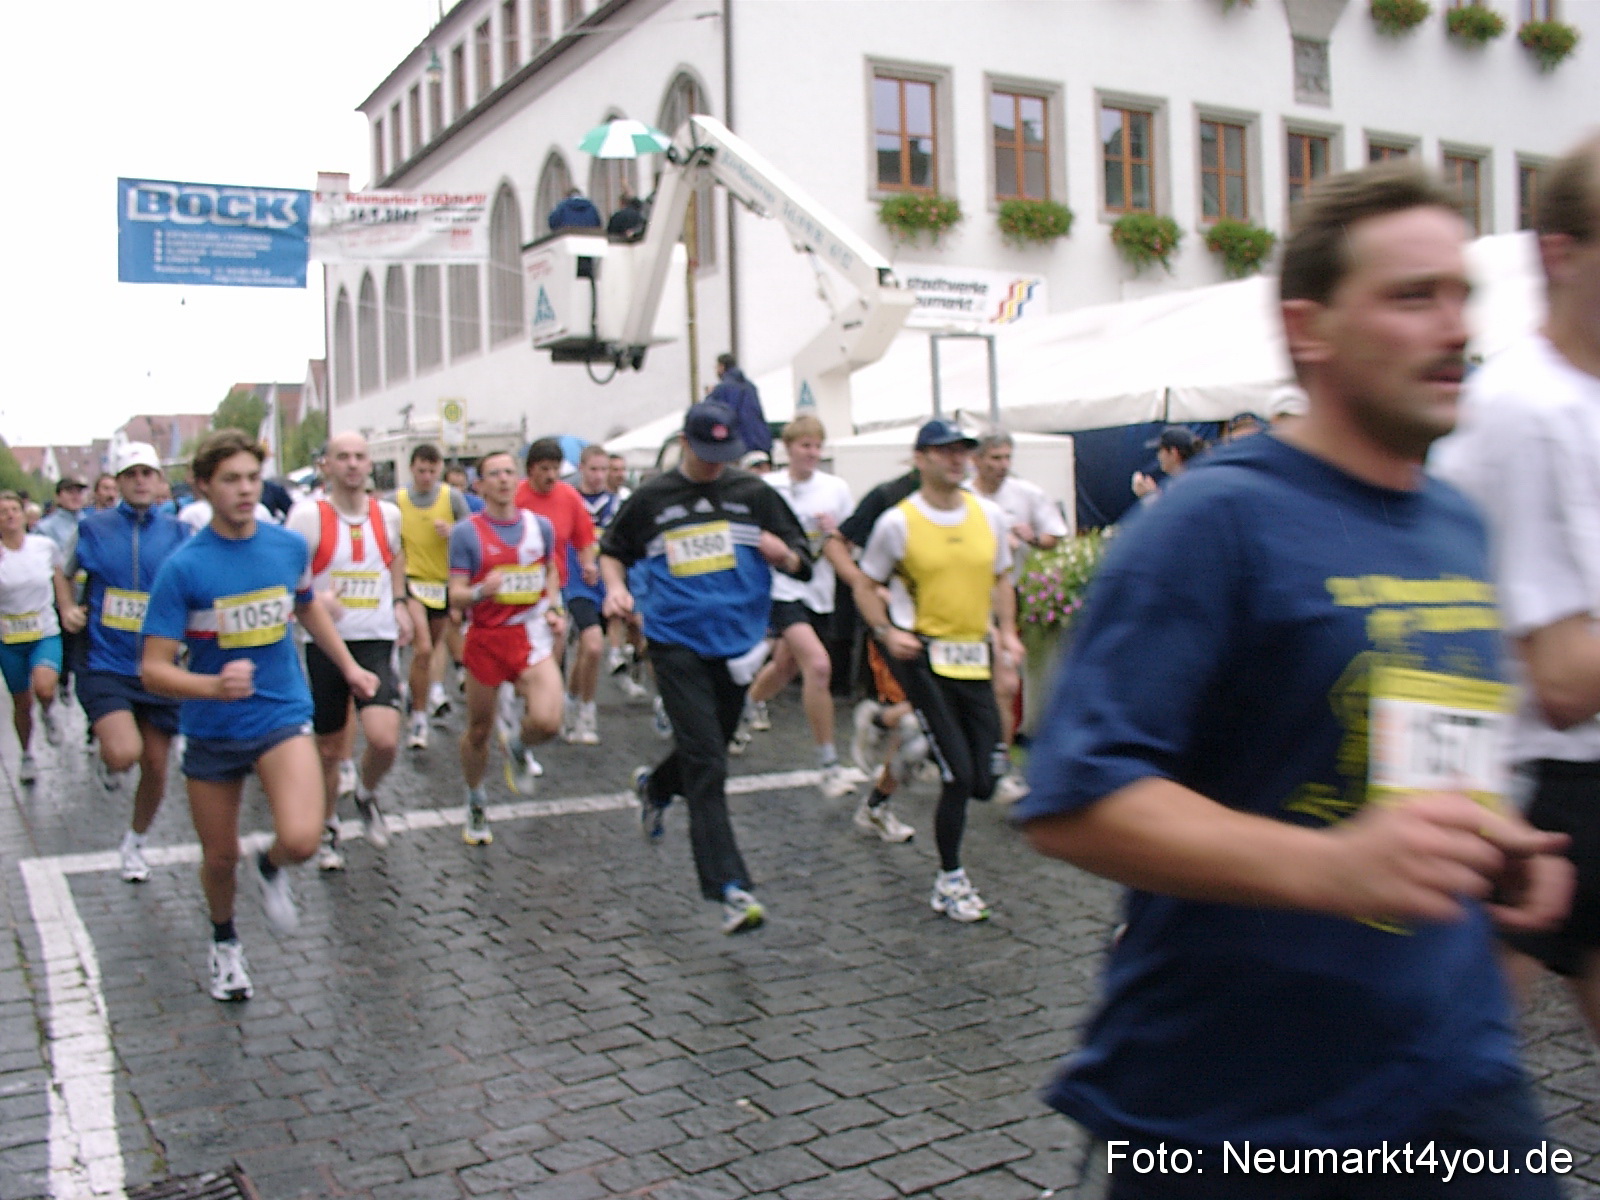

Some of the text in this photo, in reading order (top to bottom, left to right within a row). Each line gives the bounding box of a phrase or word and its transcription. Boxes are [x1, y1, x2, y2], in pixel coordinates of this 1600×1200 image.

[127, 182, 299, 229] BOCK
[115, 599, 147, 619] 132
[232, 600, 285, 631] 1052
